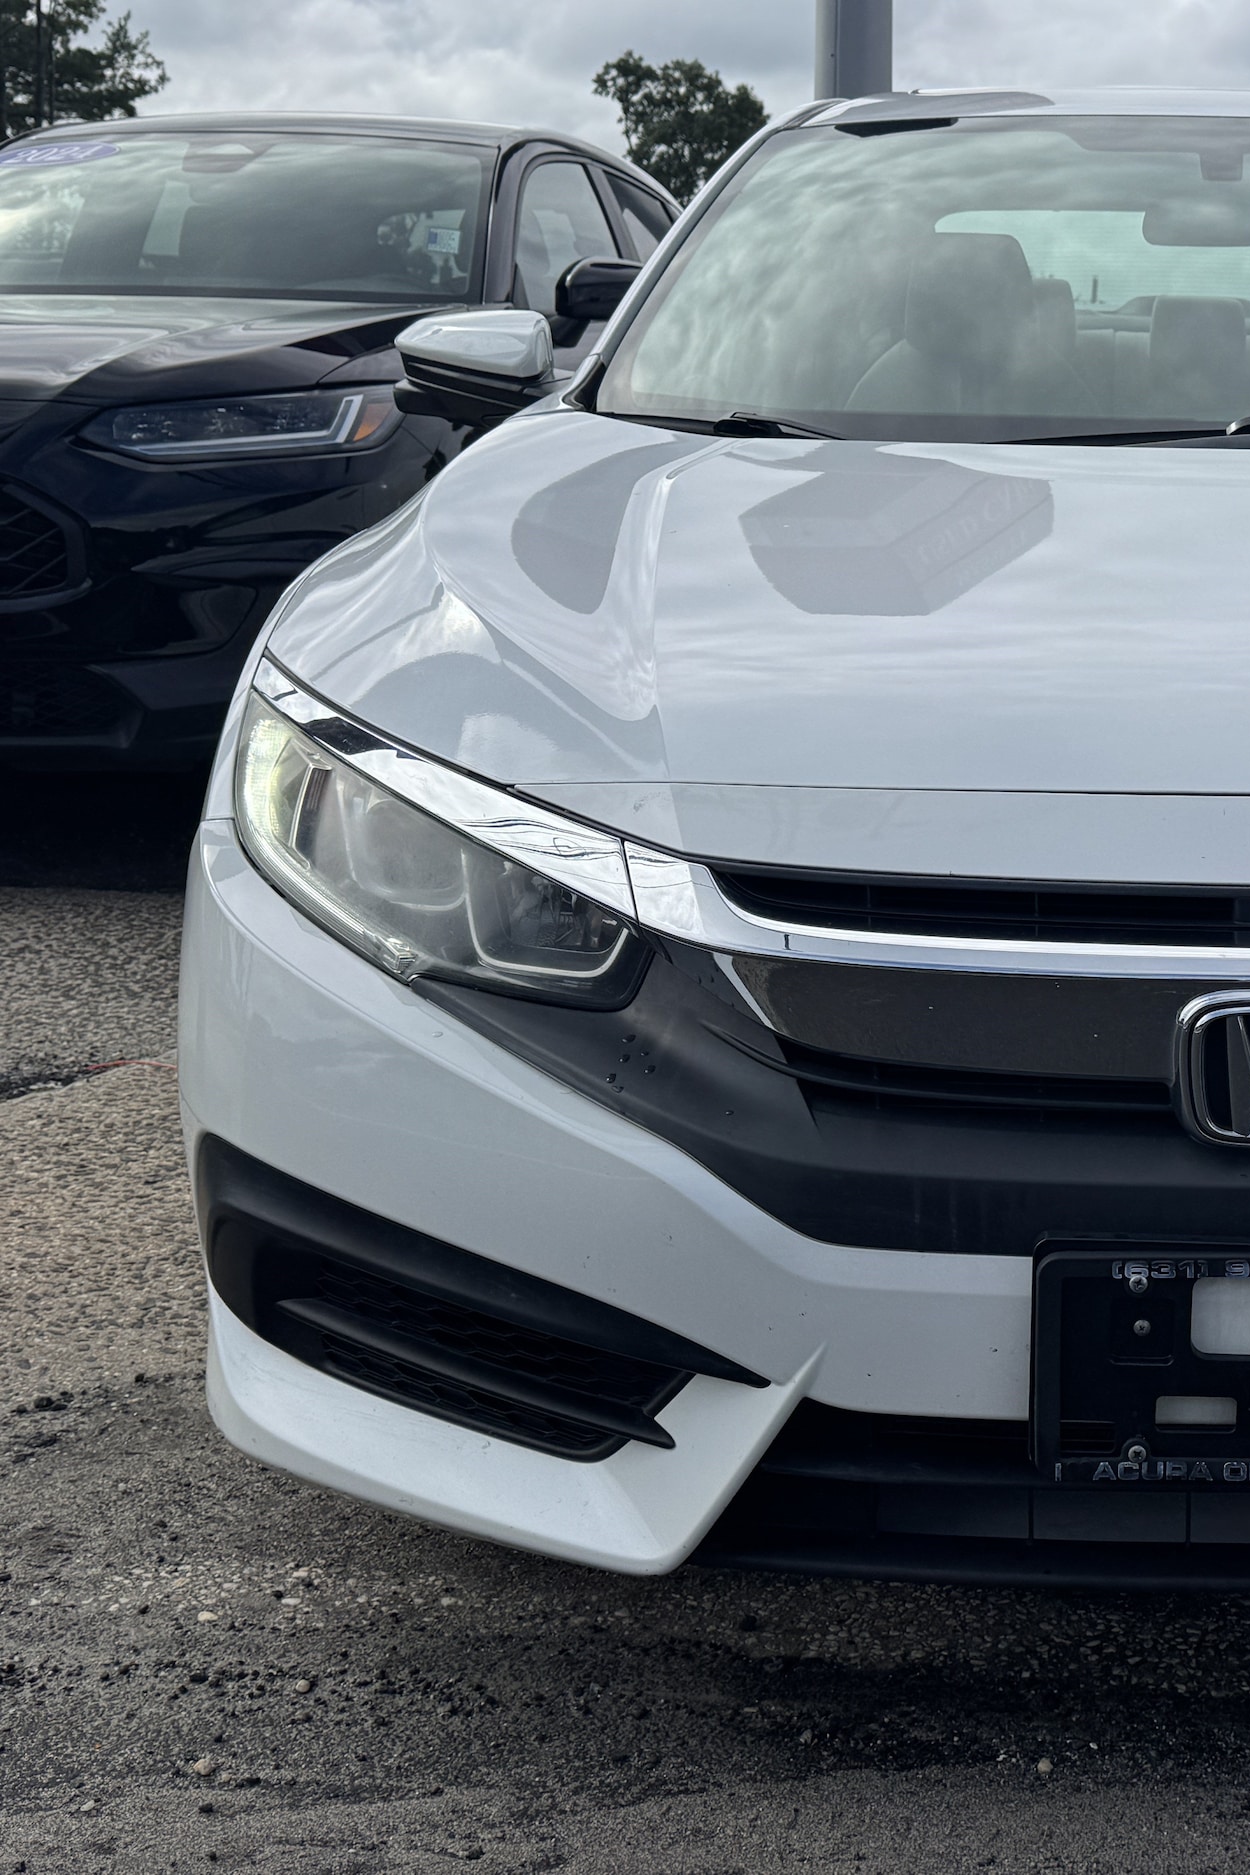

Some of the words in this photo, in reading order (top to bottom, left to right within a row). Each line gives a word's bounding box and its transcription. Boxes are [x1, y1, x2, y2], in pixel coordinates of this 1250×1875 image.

[2, 144, 104, 164] 2024
[1111, 1259, 1209, 1280] (631)
[1092, 1461, 1214, 1482] ACURA
